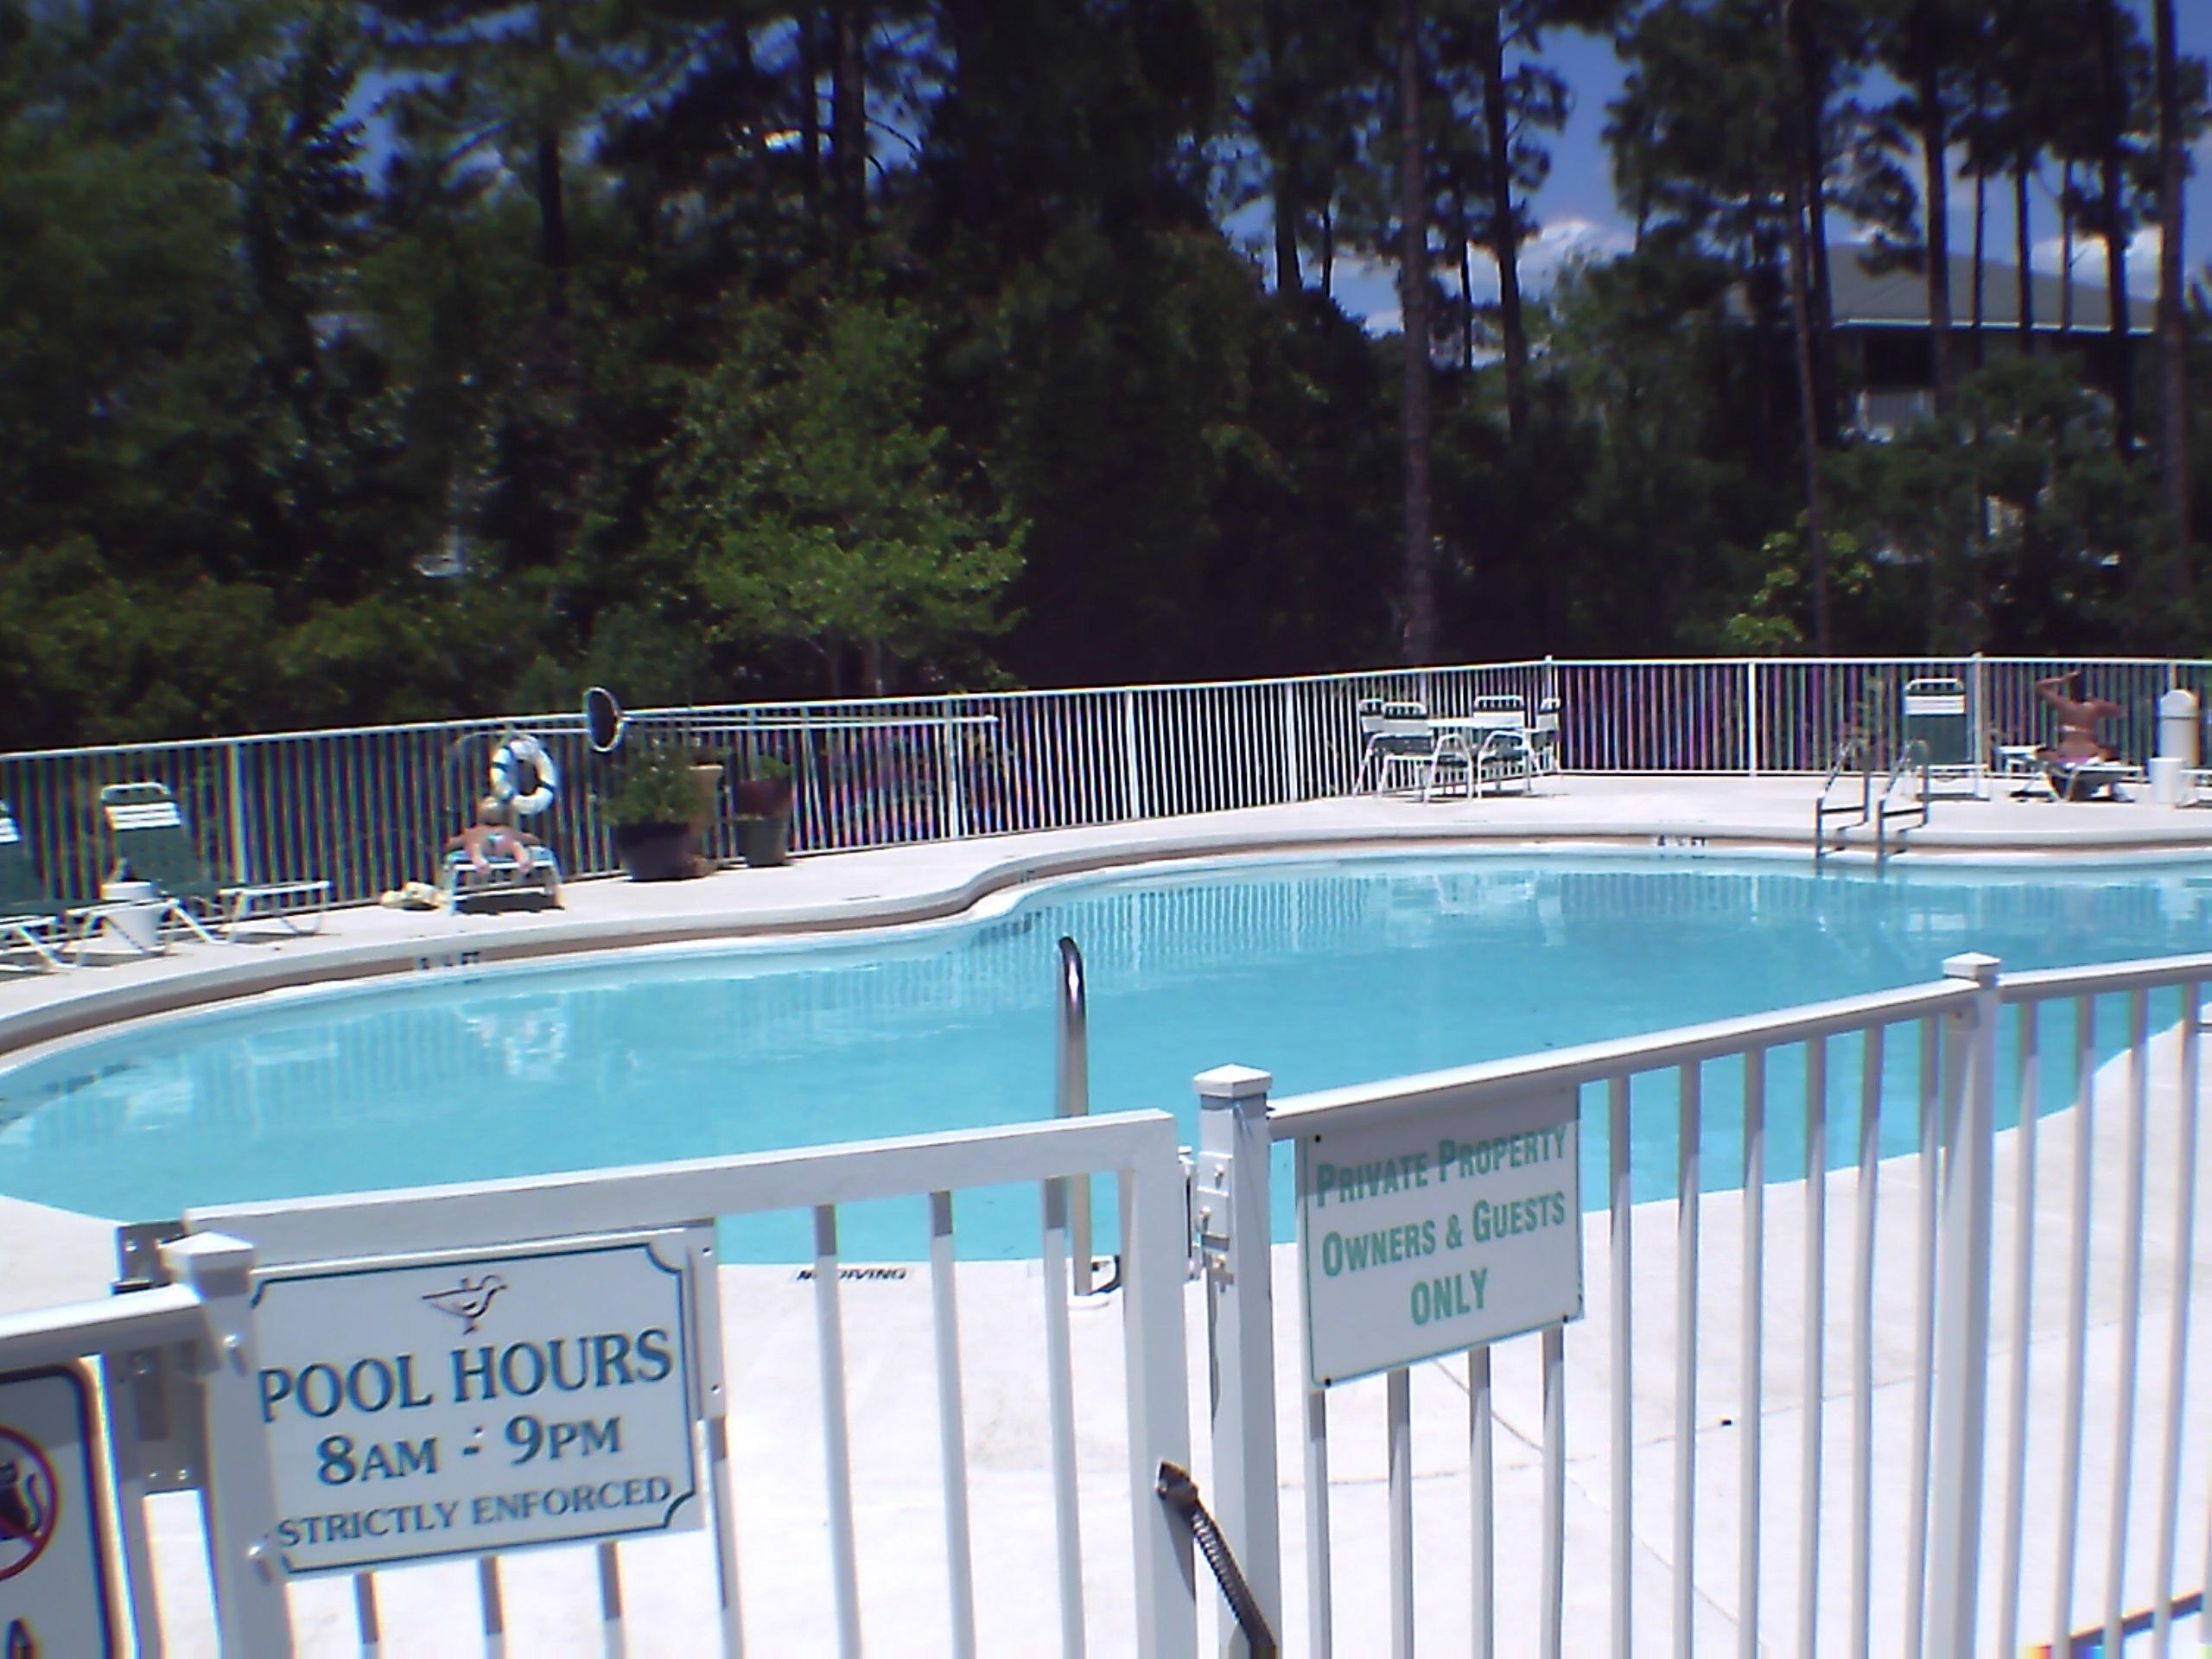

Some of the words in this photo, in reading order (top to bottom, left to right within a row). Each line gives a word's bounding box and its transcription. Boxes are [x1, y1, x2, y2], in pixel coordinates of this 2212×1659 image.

[1317, 1153, 1428, 1208] PRIVATE
[1440, 1125, 1568, 1182] PROPERTY
[1322, 1220, 1436, 1277] OWNERS
[1446, 1214, 1463, 1249] &
[1472, 1192, 1566, 1243] GUESTS
[1410, 1267, 1489, 1326] ONLY
[259, 1354, 432, 1423] POOL
[452, 1328, 673, 1403] HOURS
[316, 1433, 439, 1486] 8AM
[504, 1414, 622, 1466] 9PM
[276, 1500, 461, 1548] STRICTLY
[473, 1475, 673, 1526] ENFORCED
